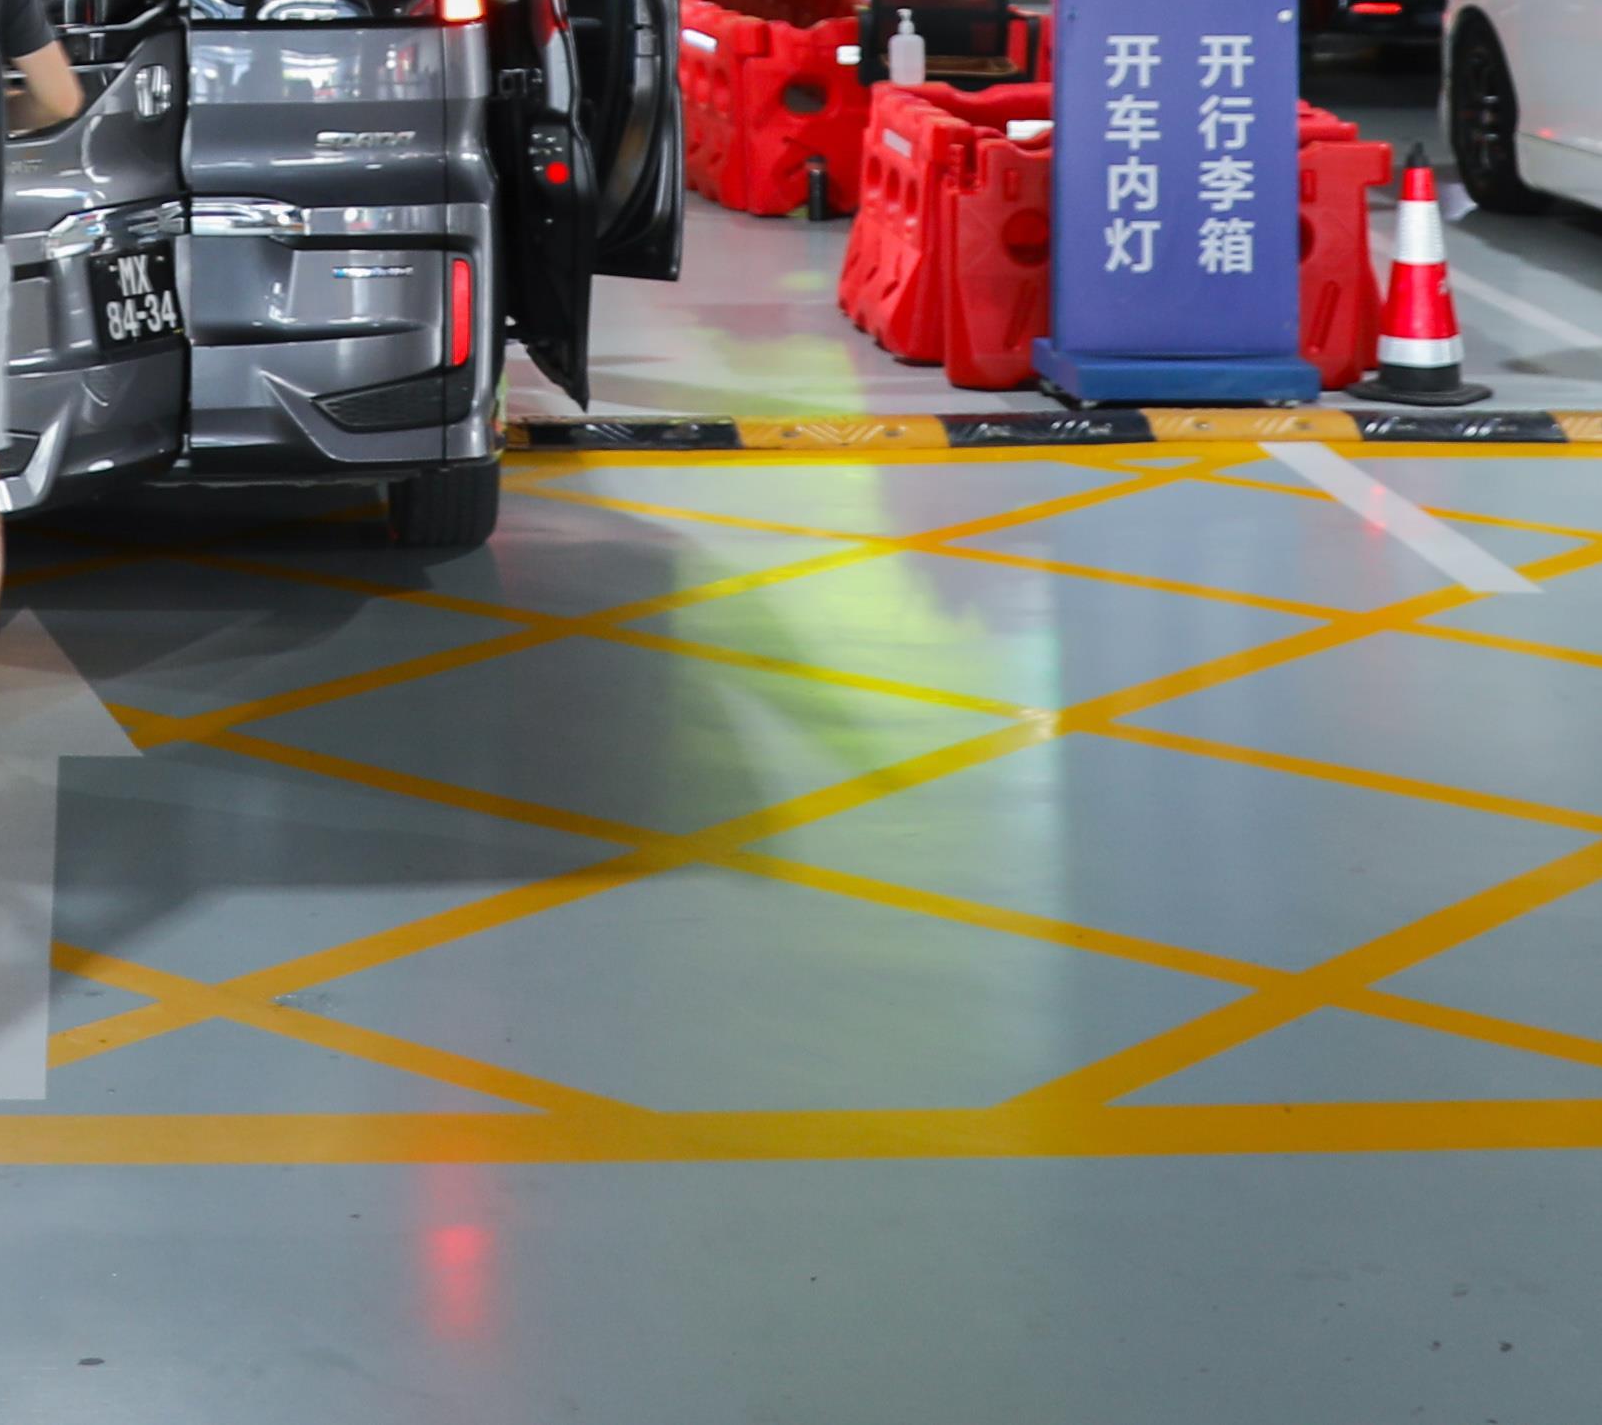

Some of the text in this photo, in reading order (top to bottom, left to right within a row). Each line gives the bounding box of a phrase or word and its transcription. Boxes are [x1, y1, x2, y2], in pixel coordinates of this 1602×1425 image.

[1104, 35, 1161, 275] 开车内灯
[1198, 35, 1256, 275] 开行李箱
[106, 290, 177, 341] 84-34
[117, 254, 153, 297] MX
